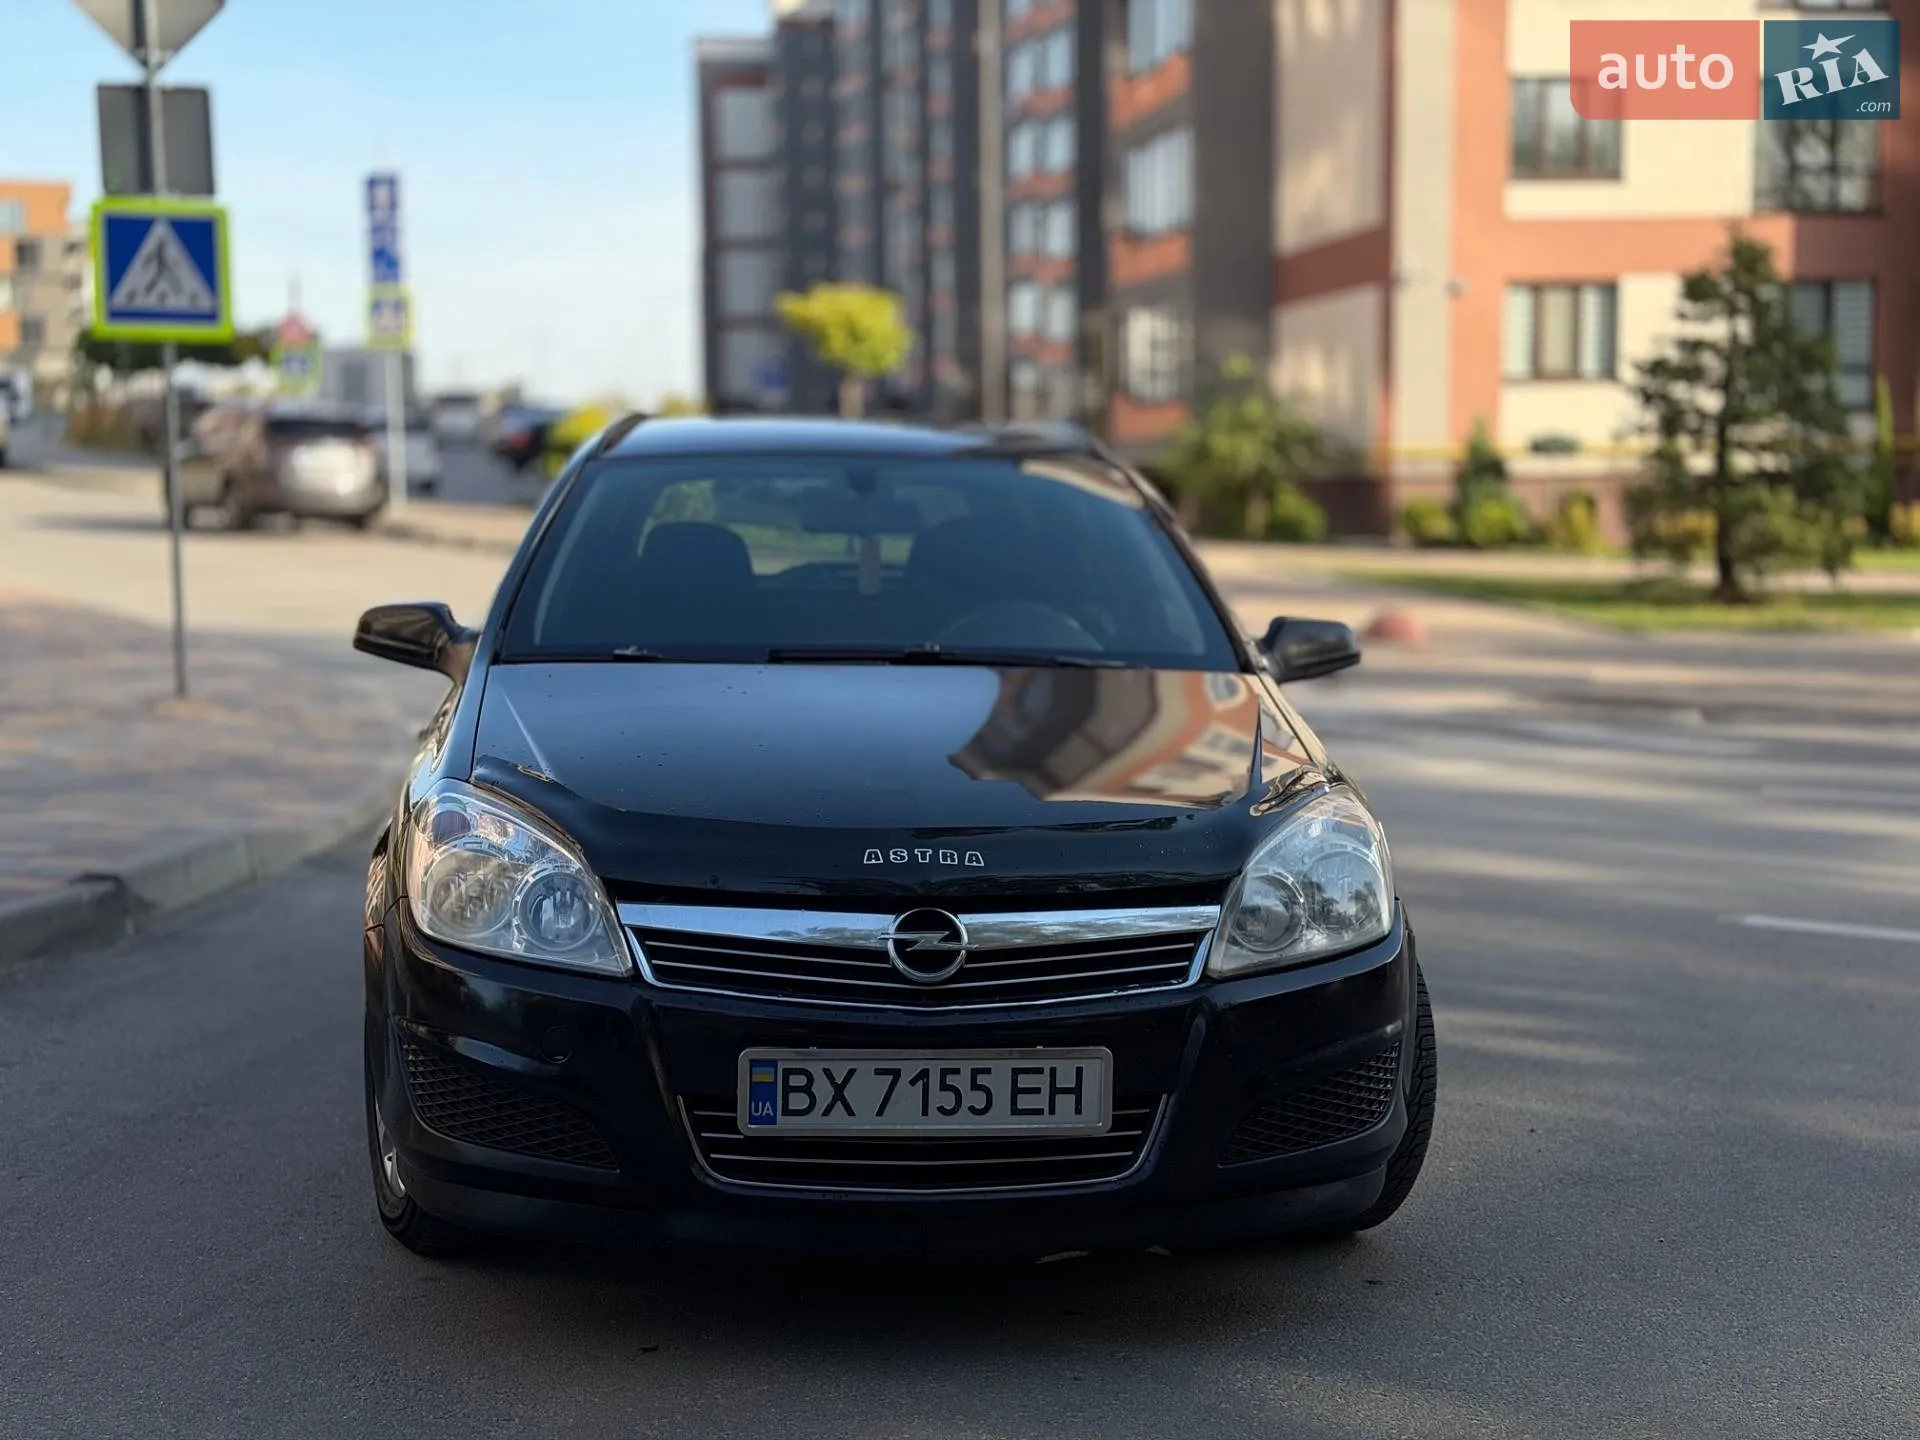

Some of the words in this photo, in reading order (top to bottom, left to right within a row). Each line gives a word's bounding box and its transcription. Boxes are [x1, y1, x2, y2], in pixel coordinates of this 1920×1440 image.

[863, 848, 985, 867] ASTRA
[781, 1067, 858, 1117] BX
[873, 1067, 994, 1117] 7155
[1010, 1066, 1083, 1116] EH
[751, 1101, 774, 1117] UA
